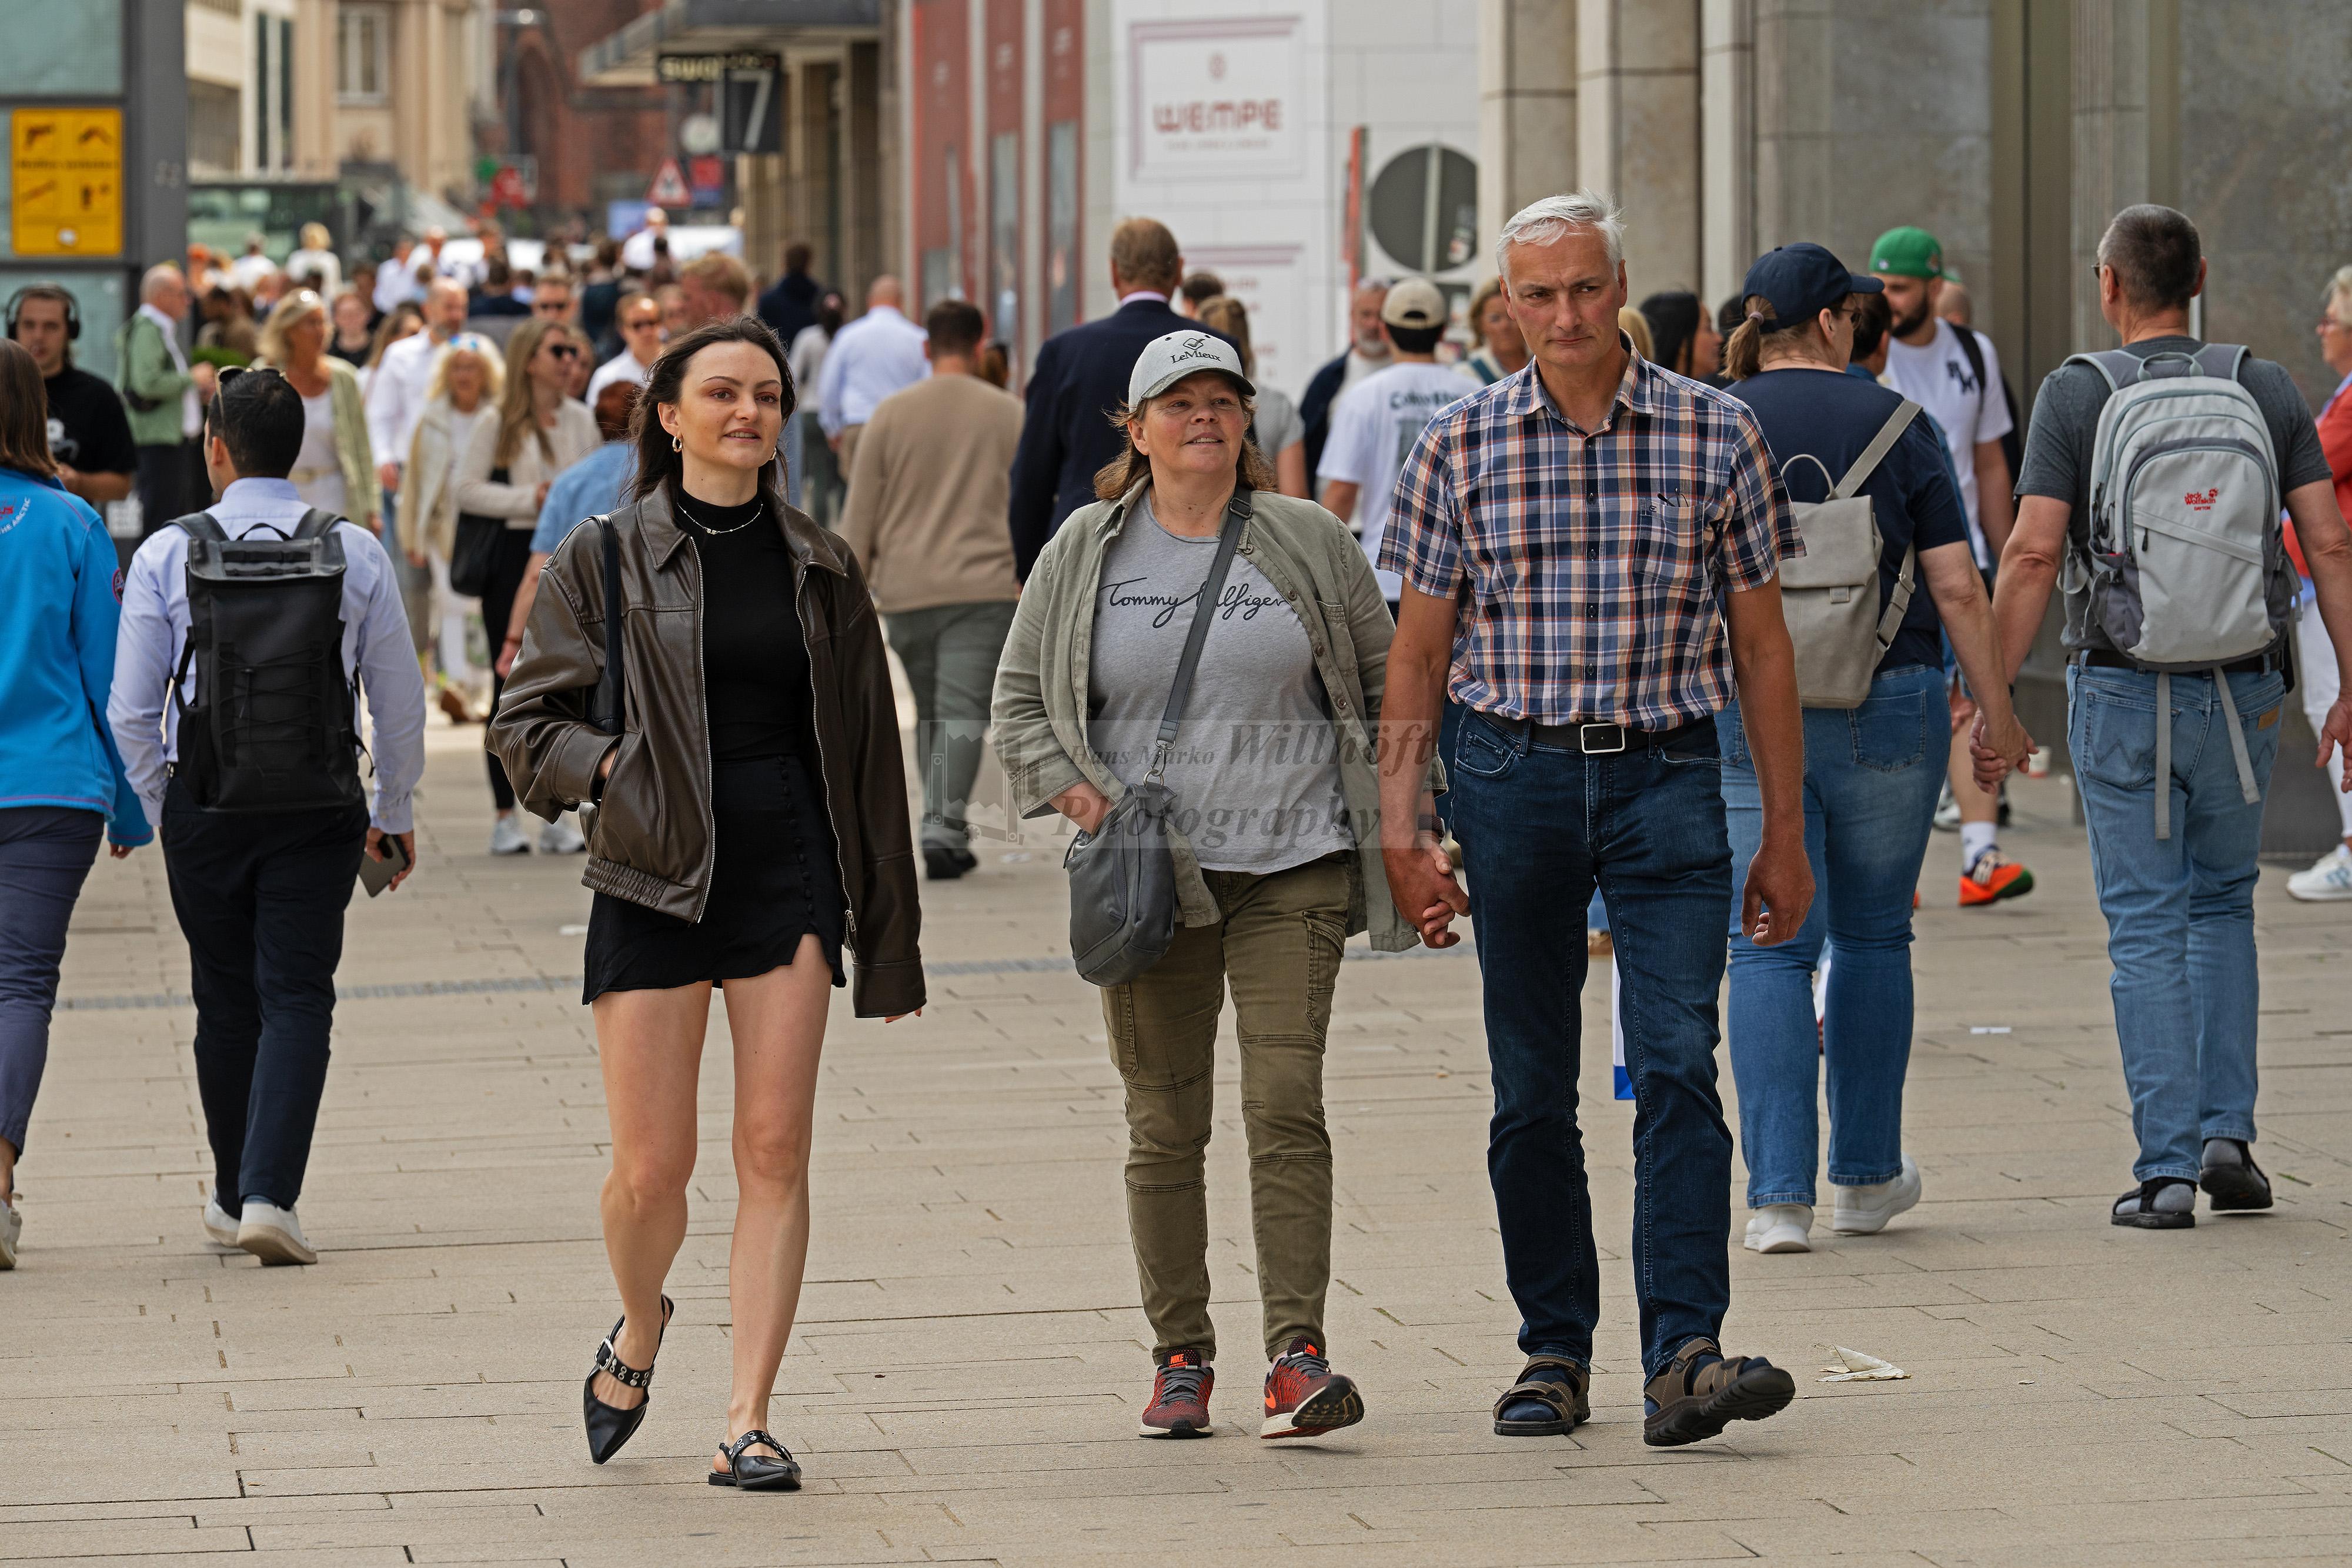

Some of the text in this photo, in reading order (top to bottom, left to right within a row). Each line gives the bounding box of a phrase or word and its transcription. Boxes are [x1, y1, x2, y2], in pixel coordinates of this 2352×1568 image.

[1153, 98, 1281, 133] WEMPE
[1170, 350, 1221, 363] LeMieux
[2184, 497, 2216, 505] Wolfskin
[12, 497, 31, 527] ARCTIC
[1098, 577, 1180, 628] Tommy
[1170, 1353, 1184, 1364] NIKE
